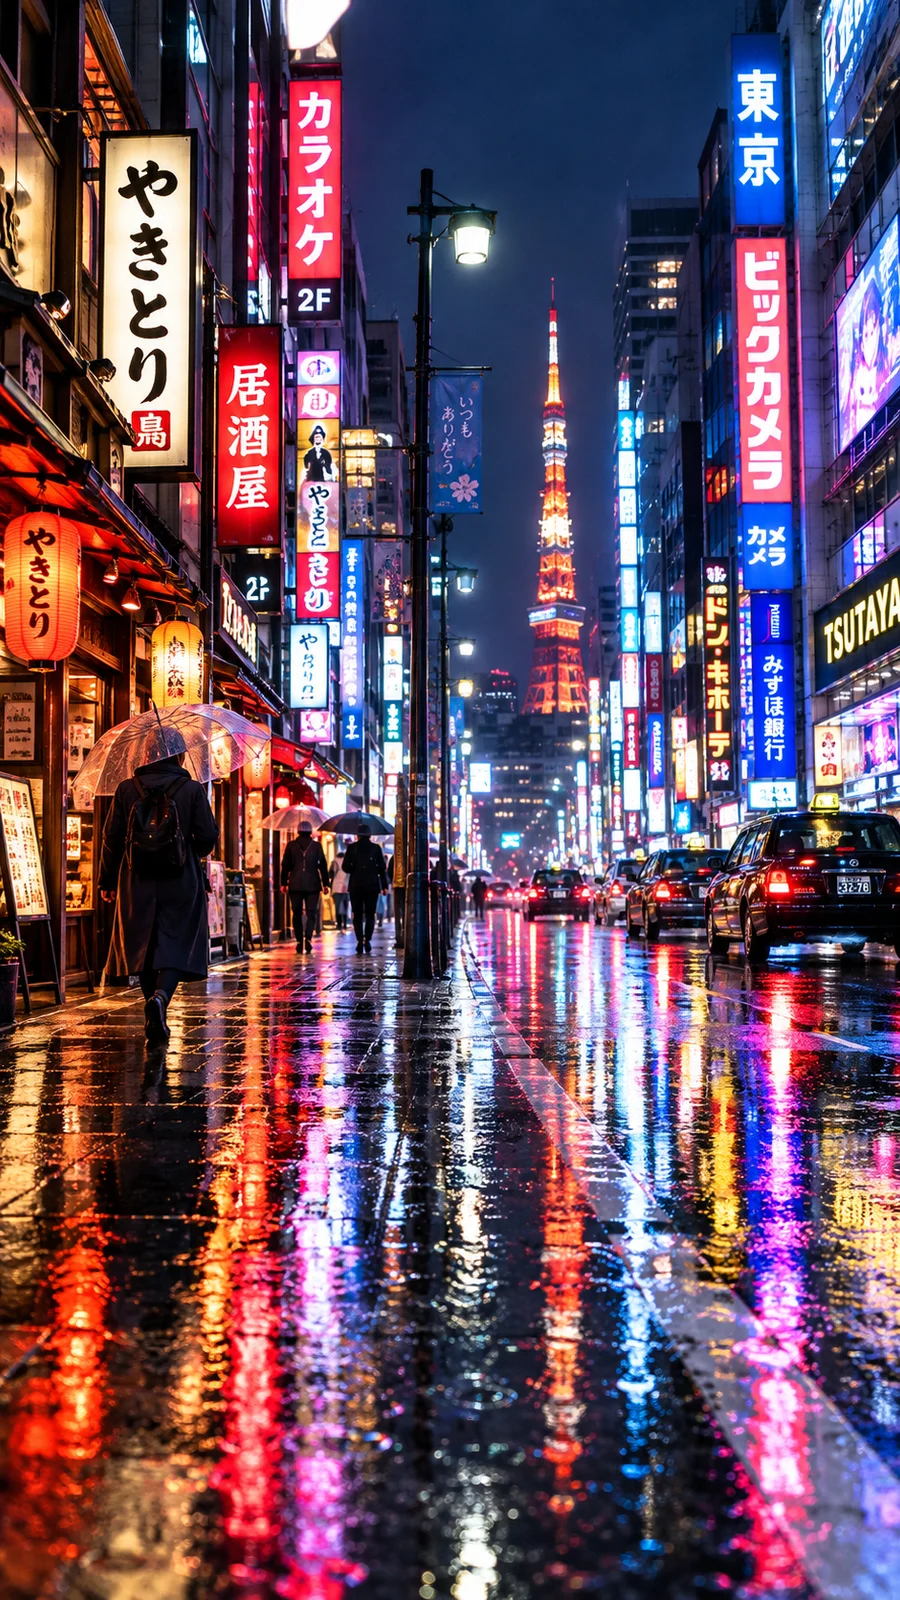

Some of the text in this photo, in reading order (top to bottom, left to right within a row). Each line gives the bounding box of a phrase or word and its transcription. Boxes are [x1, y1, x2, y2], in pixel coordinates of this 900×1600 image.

[295, 91, 334, 266] カラオケ
[737, 69, 780, 187] 東京
[118, 159, 178, 404] やきとり
[297, 288, 332, 312] 2F
[459, 396, 474, 439] いつも
[743, 251, 783, 491] ビックカメラ
[226, 363, 270, 510] 居酒屋
[23, 527, 56, 639] やきとり
[746, 525, 786, 546] カメ
[748, 547, 787, 567] メラ
[823, 576, 900, 665] TSUTAYA
[762, 654, 786, 762] みずほ銀行
